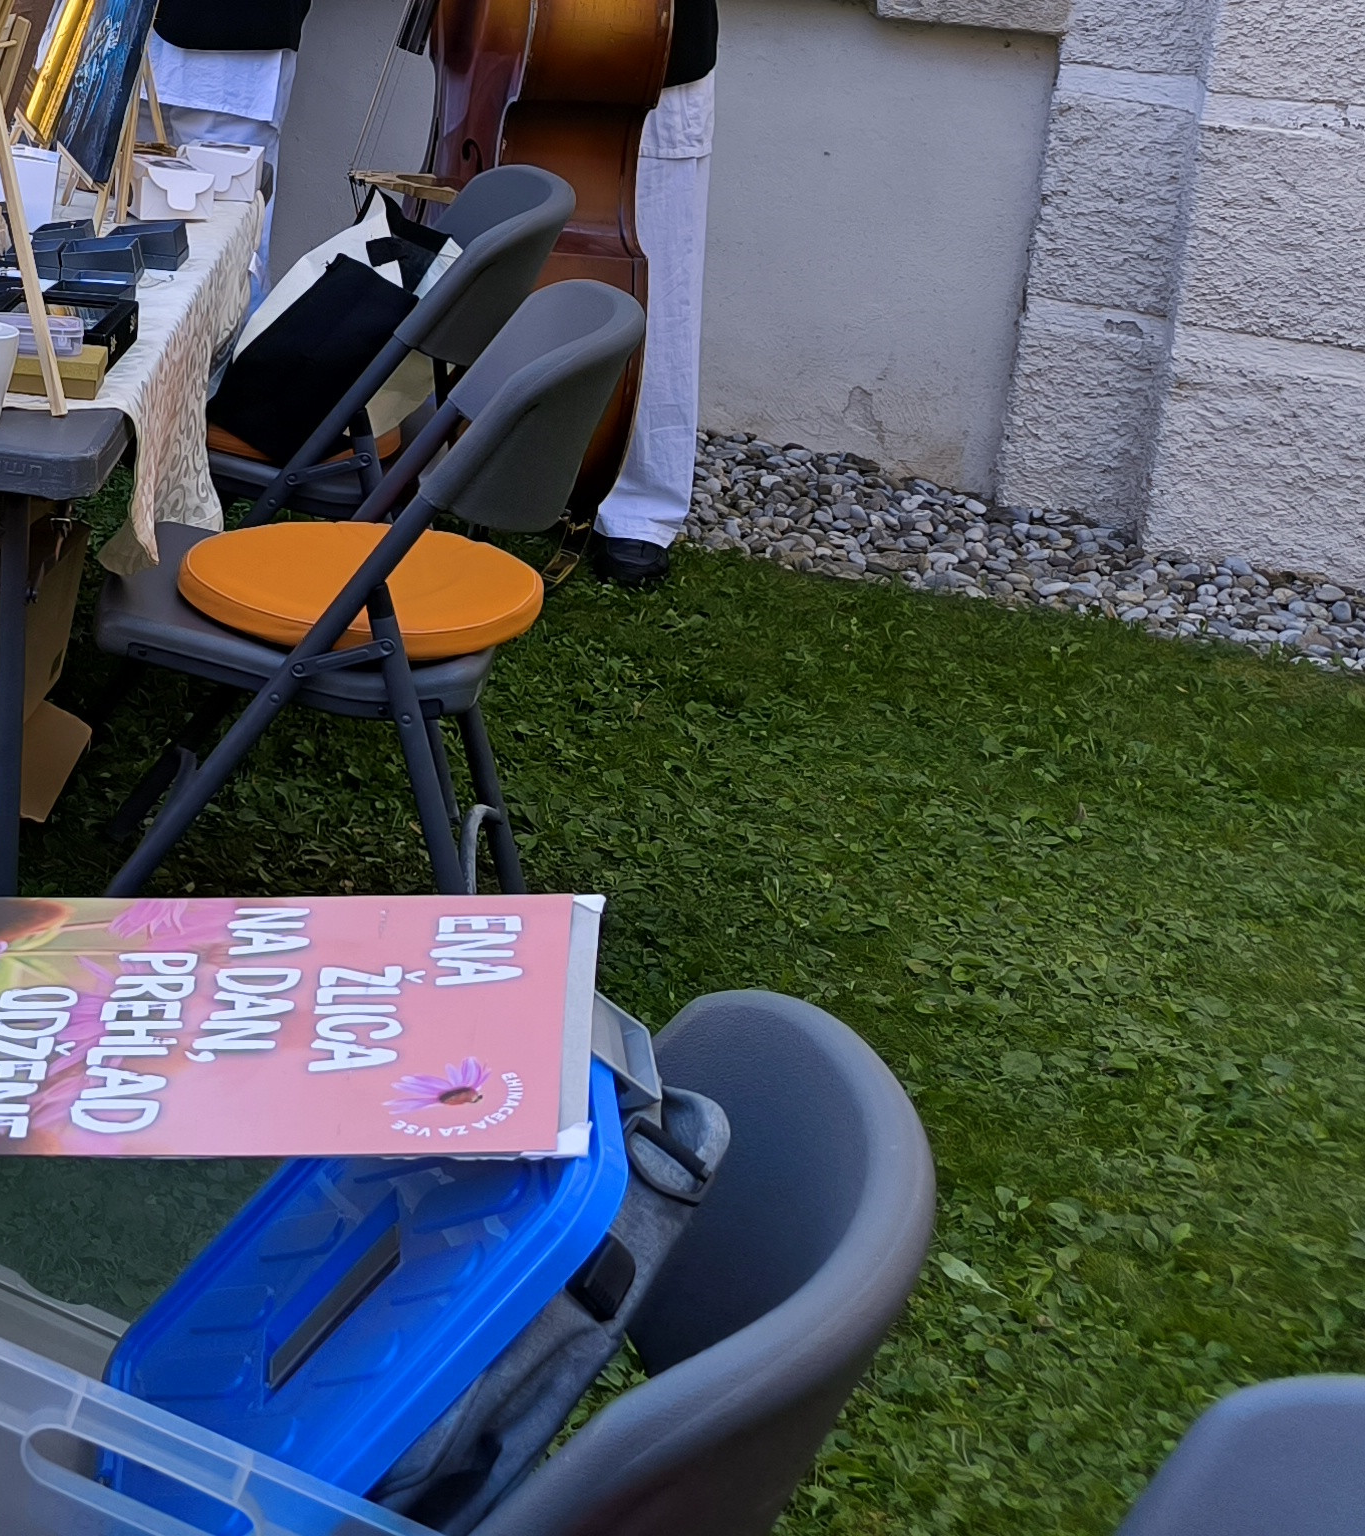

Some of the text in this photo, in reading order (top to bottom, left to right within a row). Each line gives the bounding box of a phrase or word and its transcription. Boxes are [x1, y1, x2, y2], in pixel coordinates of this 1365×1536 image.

[183, 907, 311, 1063] NA DAN,
[429, 914, 523, 987] ENA
[70, 951, 199, 1135] PREHLAD
[307, 964, 426, 1073] ŽLICA
[390, 1071, 524, 1137] EHINACEJA ZA VSE
